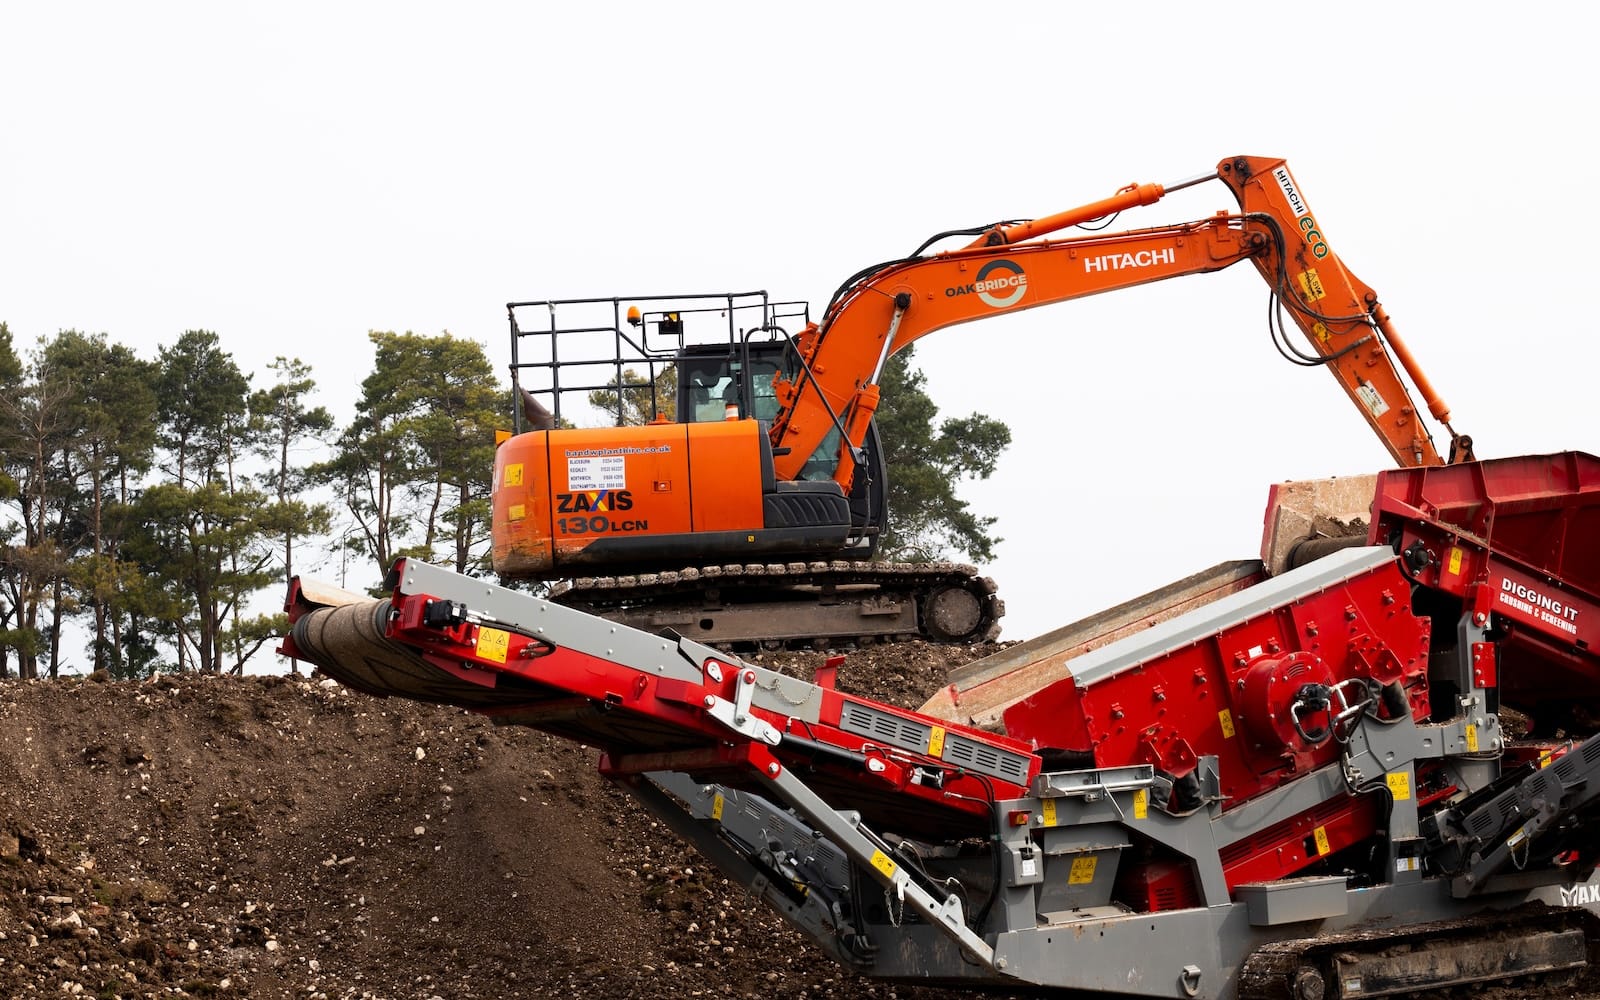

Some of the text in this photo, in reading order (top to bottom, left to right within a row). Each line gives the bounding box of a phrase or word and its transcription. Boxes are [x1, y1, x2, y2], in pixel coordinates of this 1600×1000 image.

[1276, 169, 1304, 213] HITACHI
[1299, 216, 1329, 260] eco
[1084, 248, 1176, 272] HITACHI
[945, 274, 1027, 297] OAKBRIDGE
[566, 446, 671, 458] bandwplanthire.co.uk
[556, 490, 633, 514] ZAXIS
[1499, 592, 1577, 634] CRUSHING & SCREENING
[1502, 577, 1579, 621] DIGGING IT
